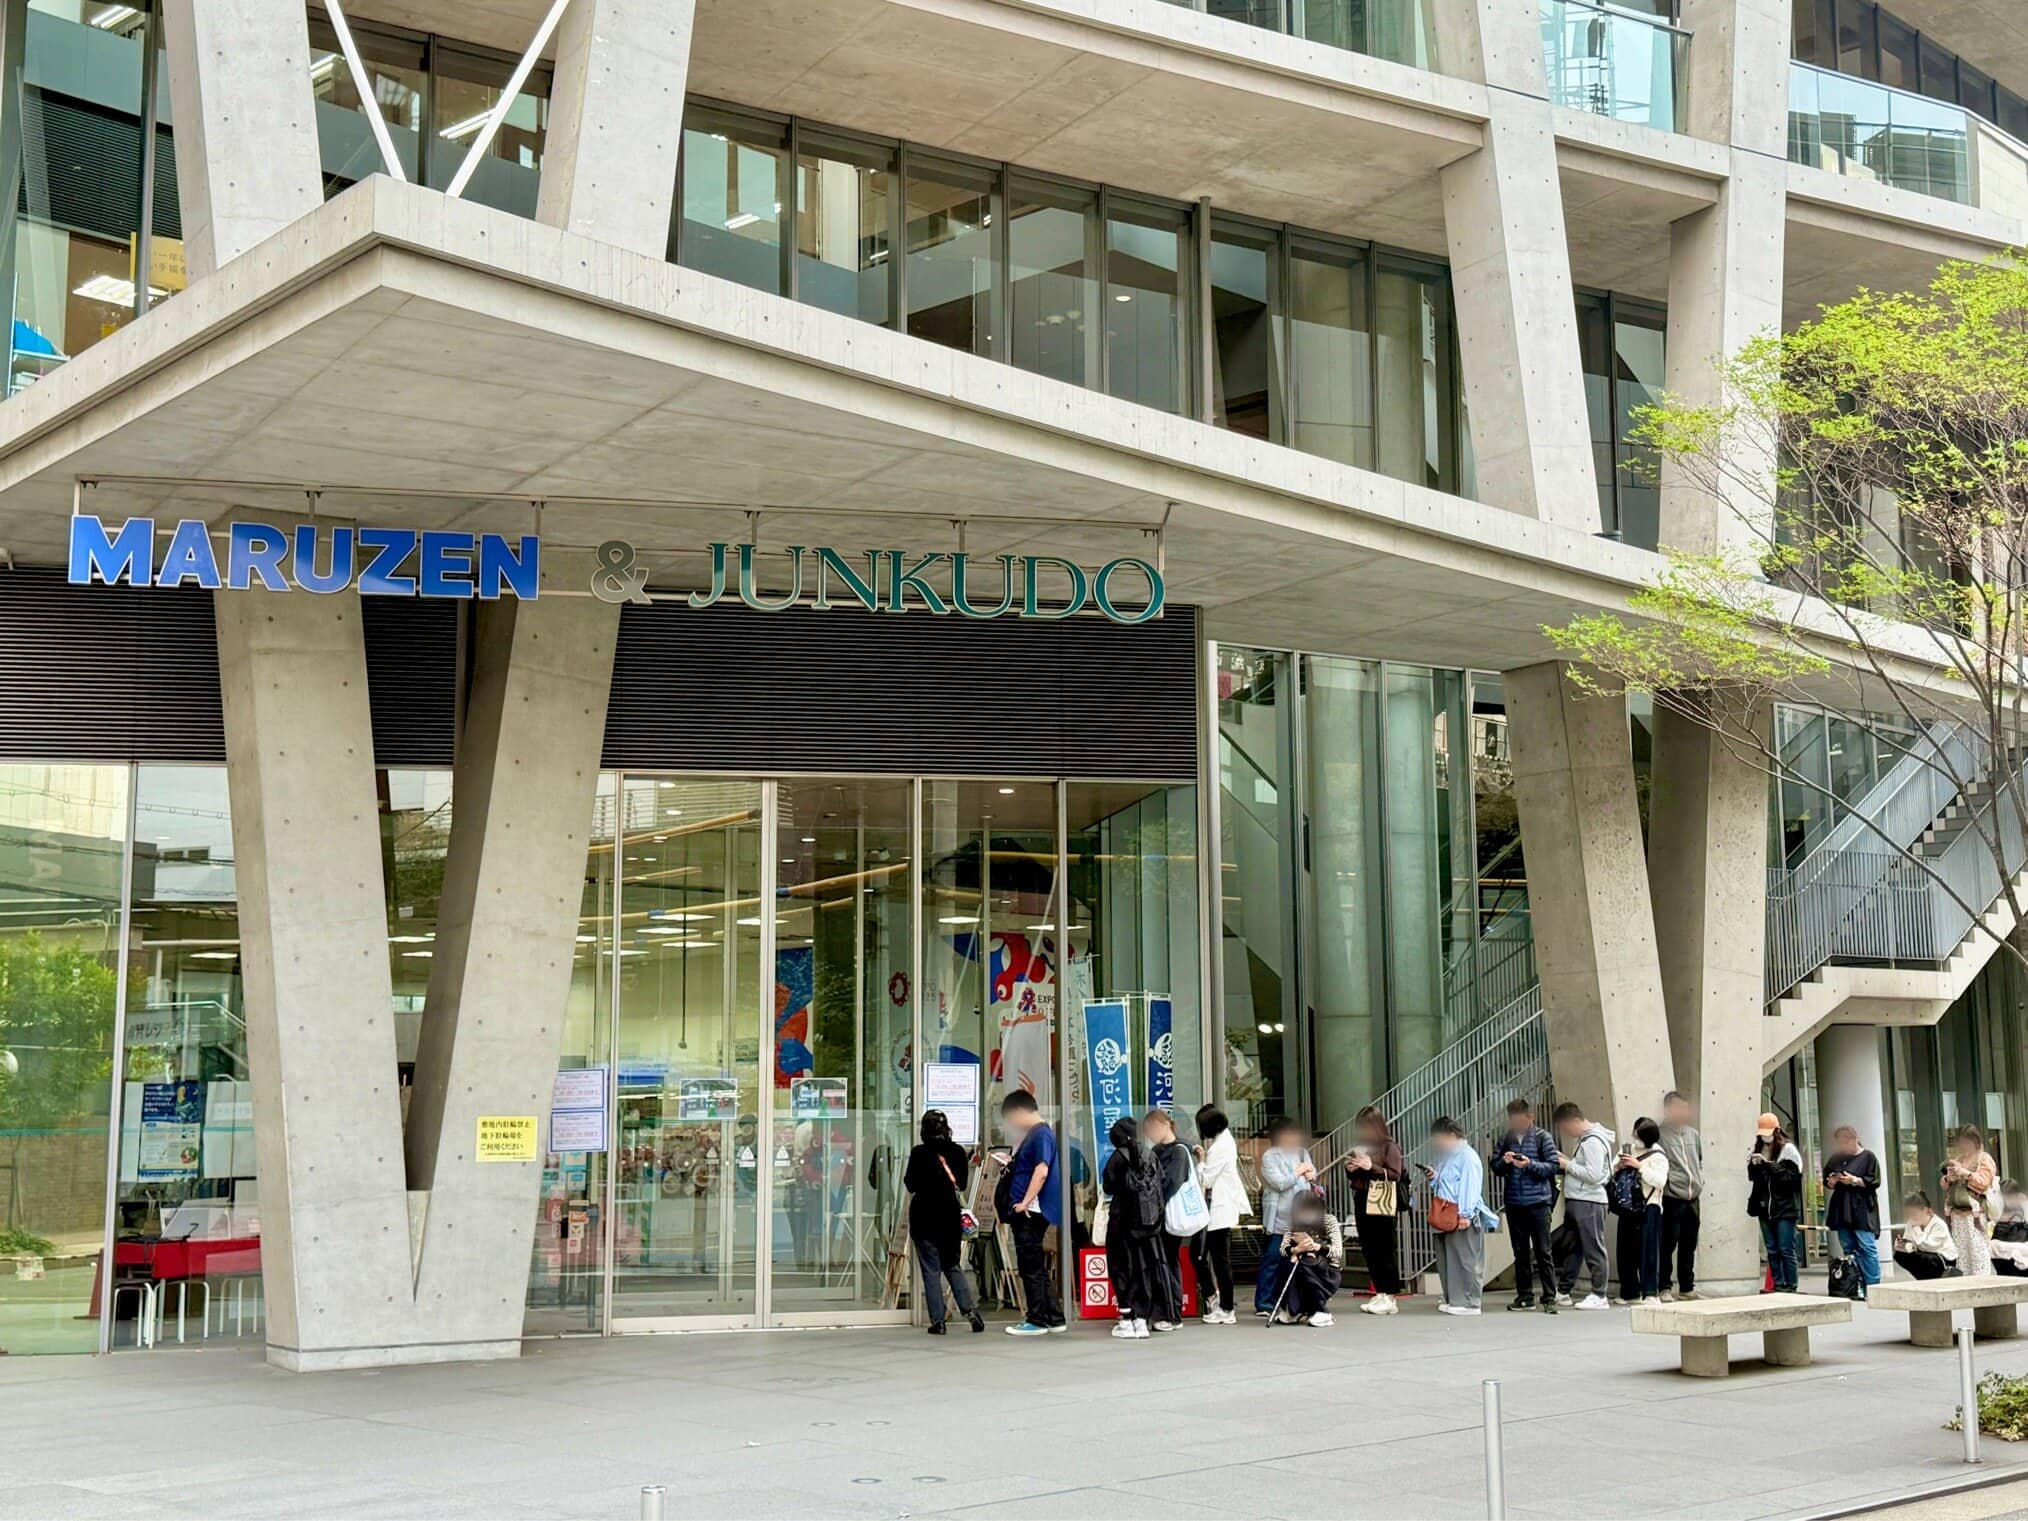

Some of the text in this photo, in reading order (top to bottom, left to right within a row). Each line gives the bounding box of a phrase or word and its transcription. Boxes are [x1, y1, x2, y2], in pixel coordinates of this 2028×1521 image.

[68, 514, 1166, 624] MARUZEN & JUNKUDO
